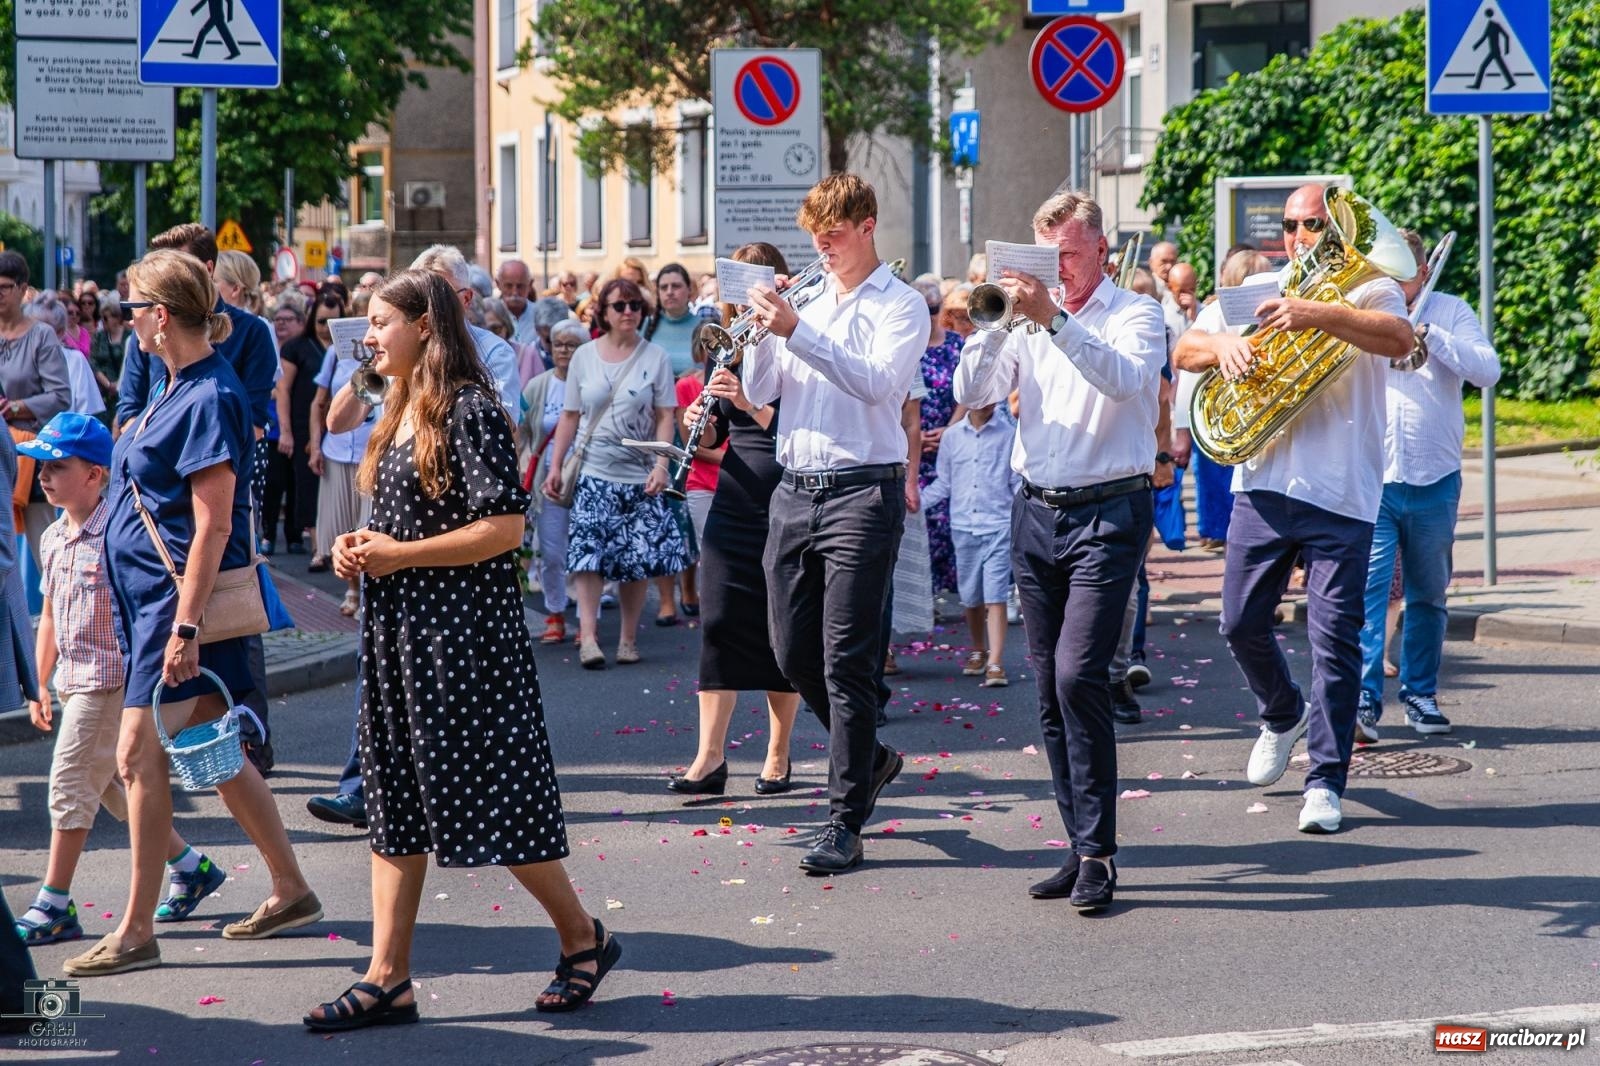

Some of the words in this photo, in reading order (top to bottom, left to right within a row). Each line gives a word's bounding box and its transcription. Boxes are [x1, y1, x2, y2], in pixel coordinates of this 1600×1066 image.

[24, 8, 32, 16] w
[27, 56, 49, 65] Karty
[52, 57, 101, 66] parkingowe
[85, 66, 114, 75] Miasta
